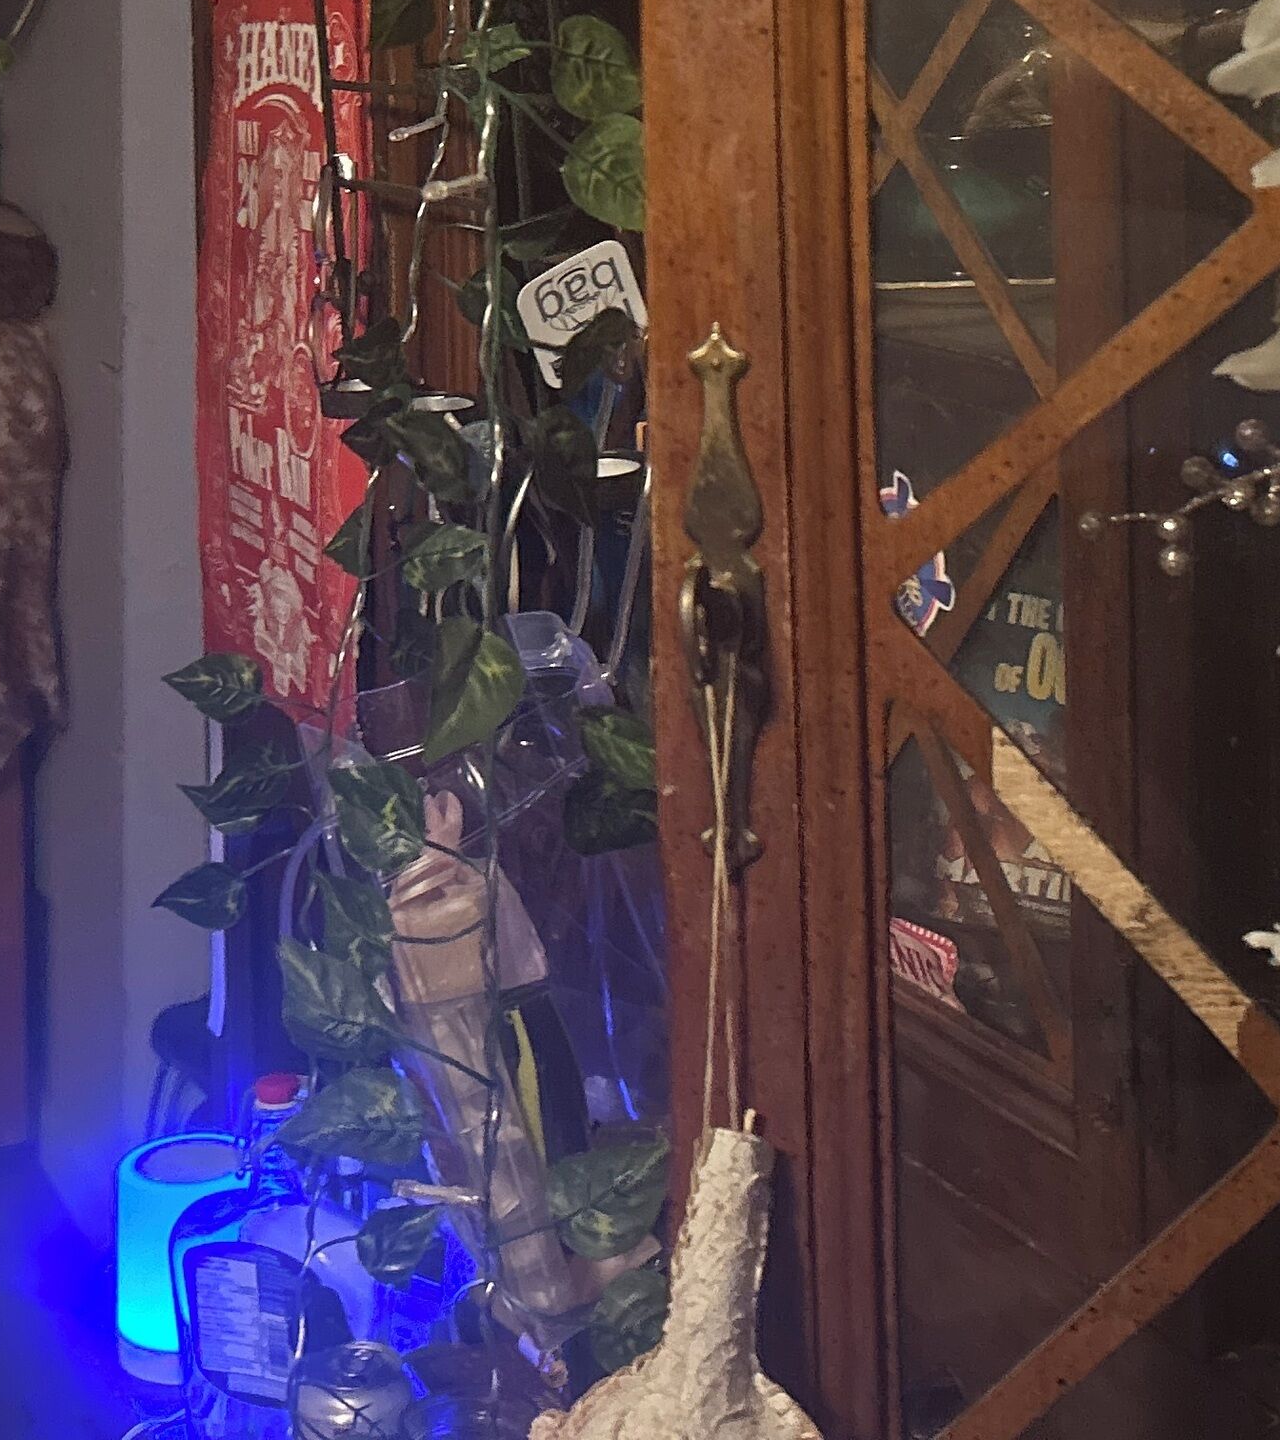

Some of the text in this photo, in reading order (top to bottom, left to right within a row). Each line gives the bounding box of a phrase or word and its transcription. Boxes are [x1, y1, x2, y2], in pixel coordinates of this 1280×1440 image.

[535, 257, 624, 322] bag
[1007, 592, 1052, 630] THE
[994, 663, 1024, 693] OF
